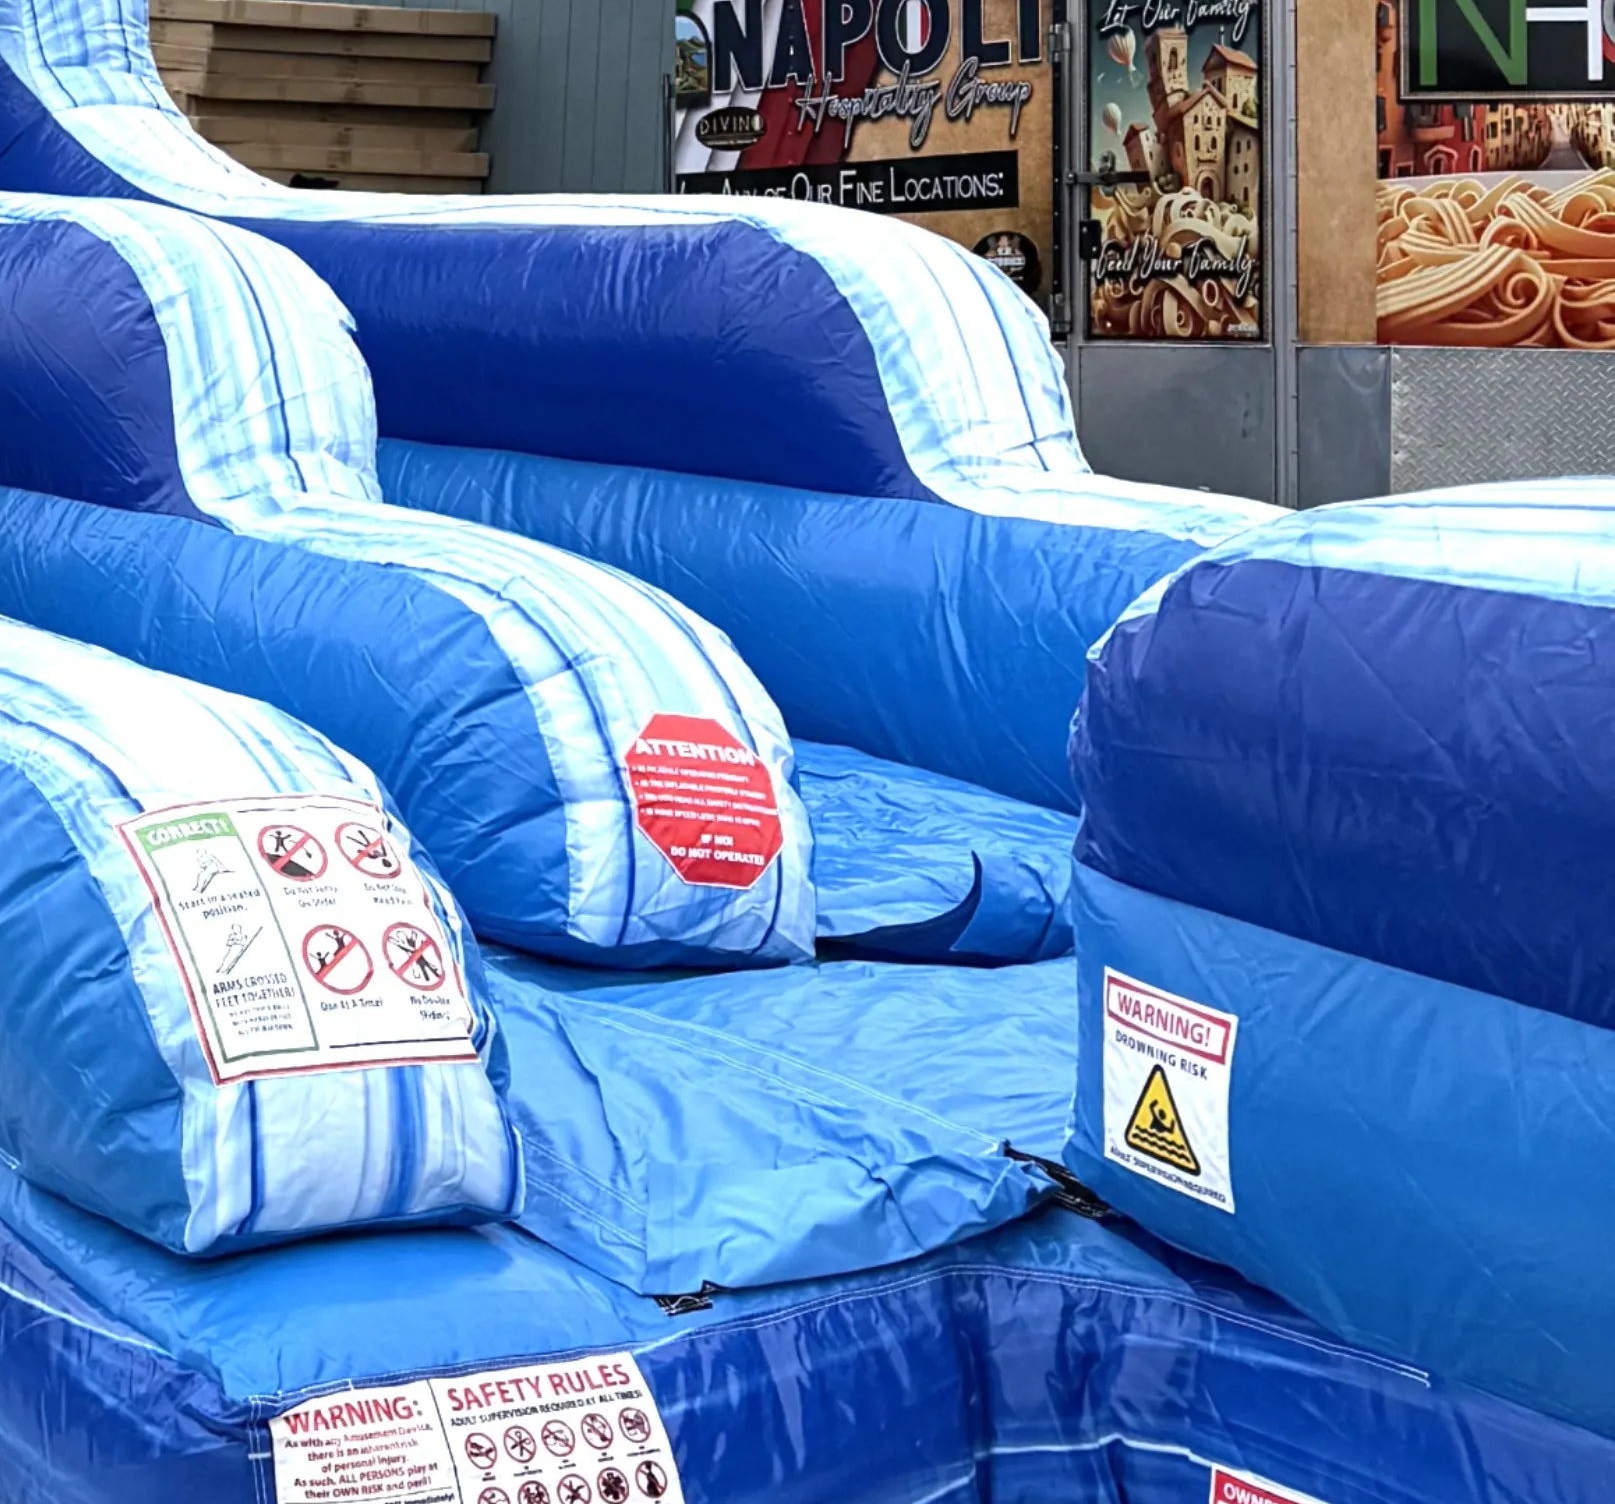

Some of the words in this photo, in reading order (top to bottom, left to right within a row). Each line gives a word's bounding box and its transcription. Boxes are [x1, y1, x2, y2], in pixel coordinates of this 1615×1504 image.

[796, 59, 941, 150] Hospitality
[947, 57, 1031, 138] Group
[700, 115, 764, 134] DIVINO
[1096, 235, 1140, 279] Feed
[1140, 230, 1182, 278] Your
[1184, 235, 1255, 298] Family
[635, 738, 755, 767] ATTENTION
[146, 818, 229, 845] CORRECT!
[671, 846, 686, 856] DO
[689, 848, 712, 858] NOT
[179, 896, 206, 911] Start
[202, 906, 248, 919] position.
[213, 979, 243, 995] ARMS
[244, 973, 287, 988] CROSSED
[216, 995, 239, 1008] FEET
[1117, 992, 1210, 1047] WARNING!
[1116, 1030, 1176, 1067] DROWNING
[1180, 1059, 1208, 1080] RISK
[447, 1376, 542, 1411] SAFETY
[548, 1364, 630, 1396] RULES
[599, 1393, 615, 1403] ALL
[284, 1397, 423, 1434] WARNING:
[285, 1439, 298, 1448] As
[301, 1438, 323, 1447] with
[344, 1428, 397, 1443] Amusement
[308, 1451, 334, 1461] there
[337, 1449, 344, 1457] is
[347, 1447, 359, 1455] an
[361, 1443, 400, 1454] inherent
[294, 1478, 306, 1486] As
[339, 1474, 357, 1485] ALL
[360, 1468, 404, 1481] PERSONS
[408, 1465, 426, 1476] play
[429, 1463, 438, 1471] at
[322, 1464, 332, 1473] of
[334, 1458, 375, 1473] personal
[304, 1490, 329, 1499] their
[333, 1487, 359, 1497] OWN
[361, 1485, 384, 1494] RISK
[387, 1481, 403, 1490] and
